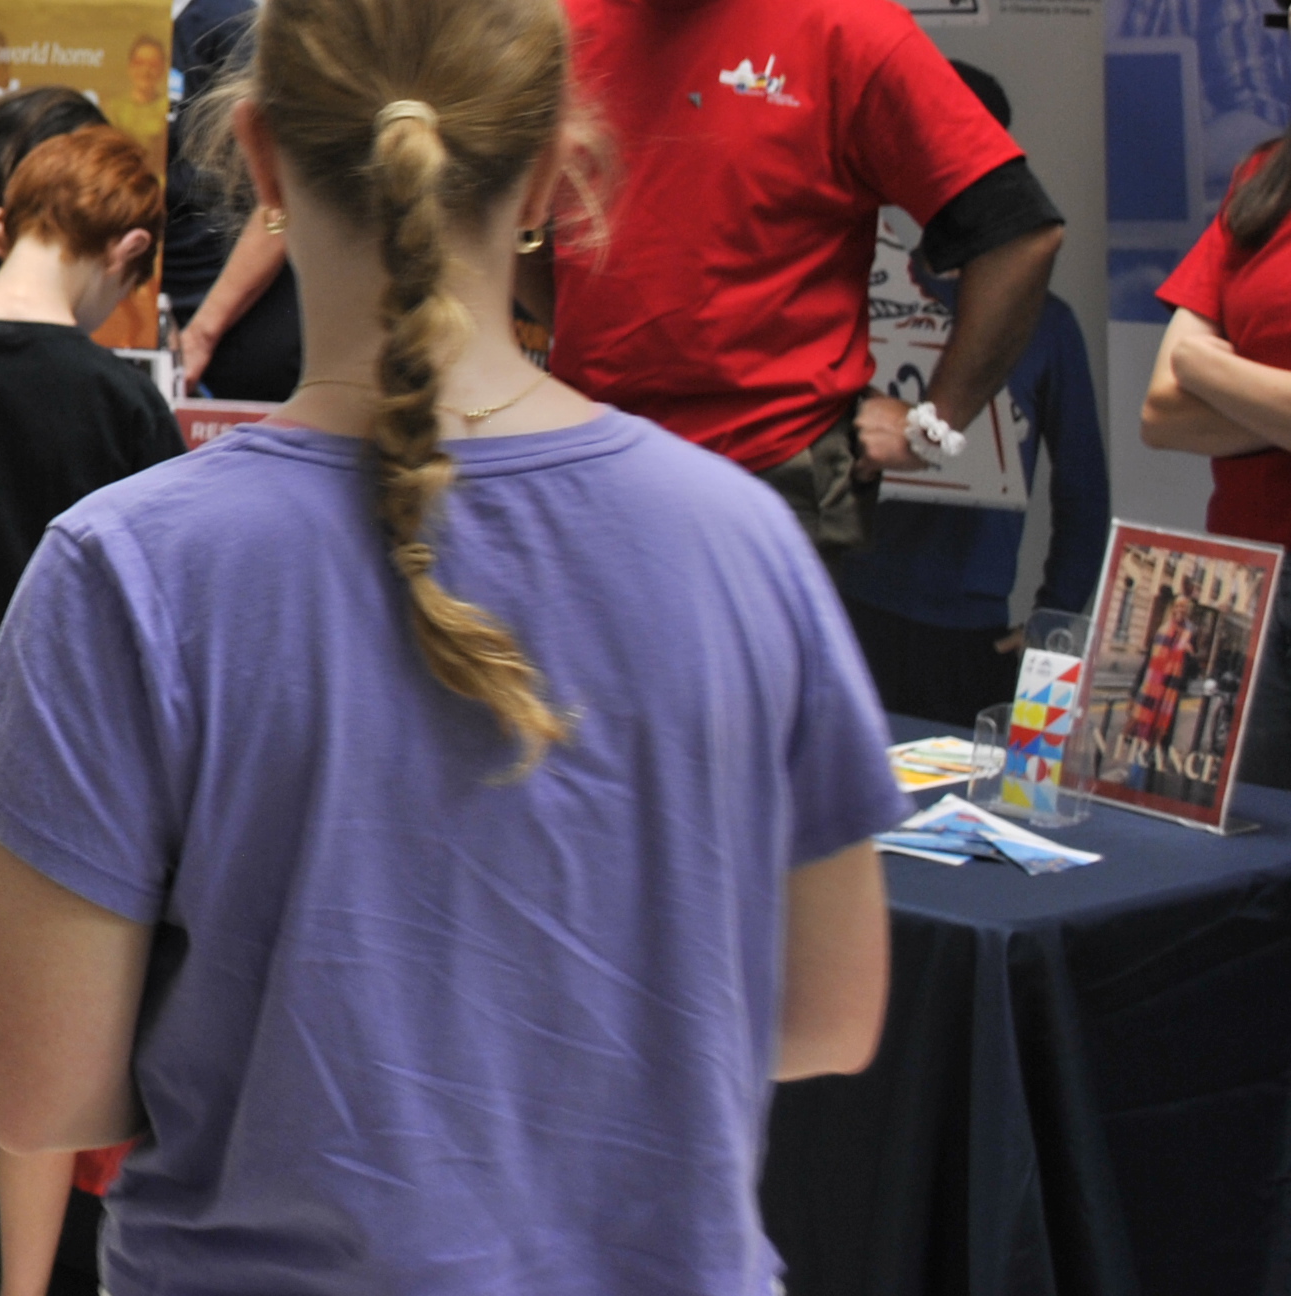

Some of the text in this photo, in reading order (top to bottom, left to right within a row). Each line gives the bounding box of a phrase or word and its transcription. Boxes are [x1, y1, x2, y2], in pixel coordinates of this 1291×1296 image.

[50, 41, 105, 67] home
[1121, 543, 1268, 617] STUDY
[1113, 733, 1223, 785] FRANCE
